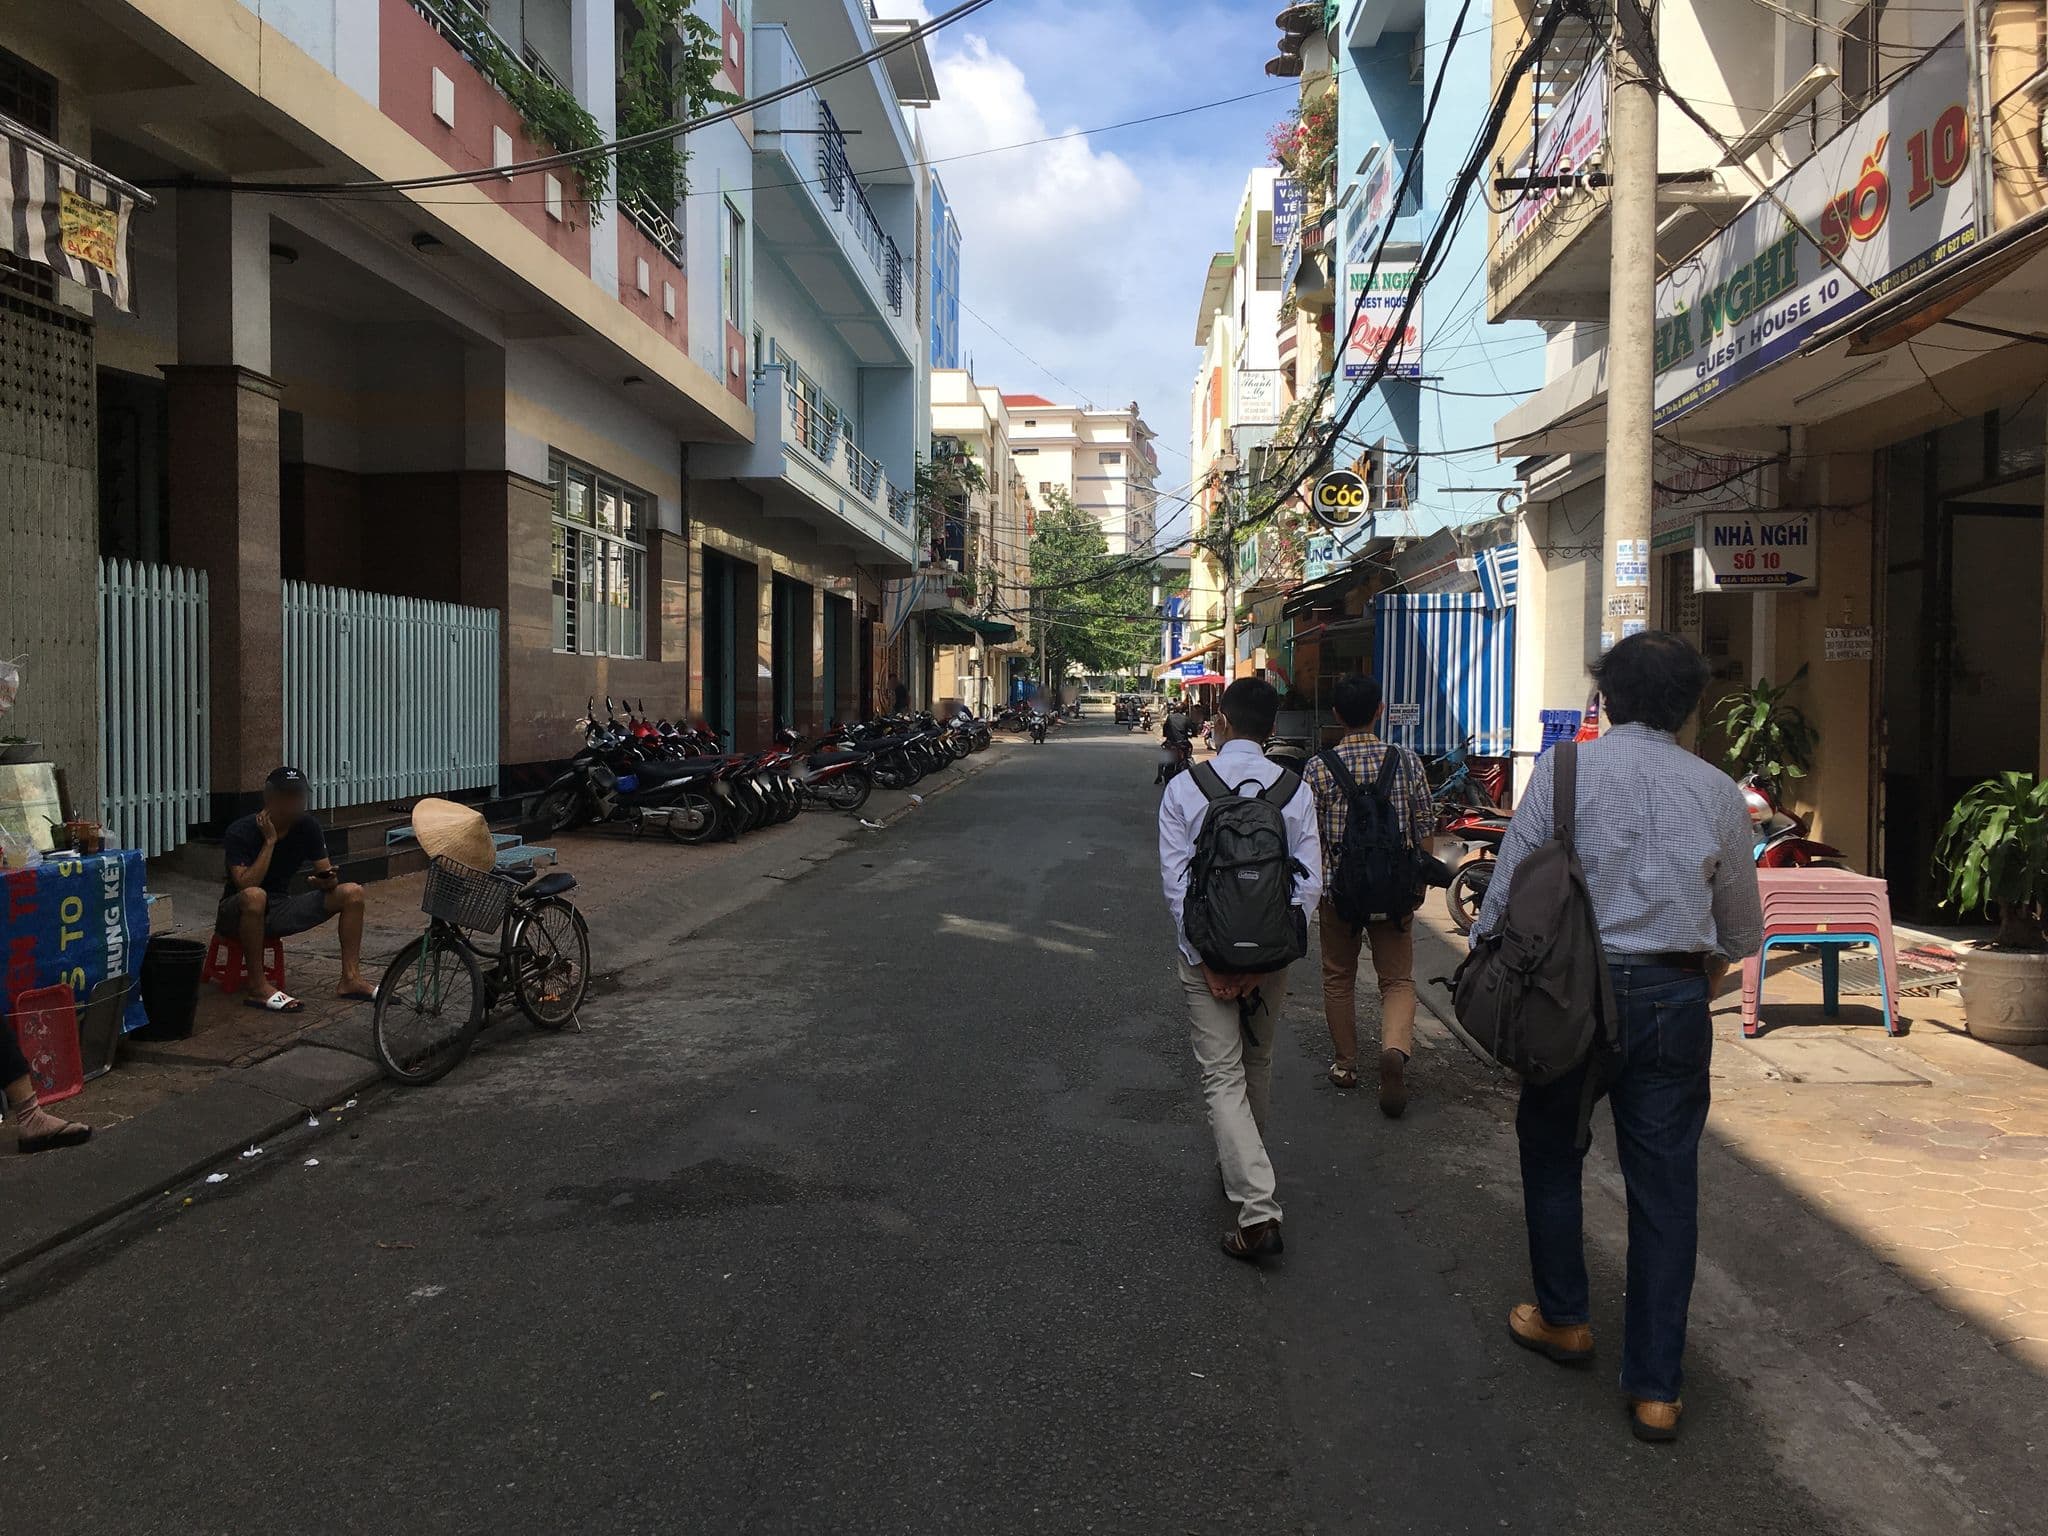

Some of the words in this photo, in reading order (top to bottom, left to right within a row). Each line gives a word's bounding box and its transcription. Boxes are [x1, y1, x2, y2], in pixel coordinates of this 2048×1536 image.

[1654, 298, 1694, 376] HÀ
[1820, 131, 1890, 269] SỐ
[1907, 104, 1969, 210] 10
[1384, 296, 1409, 309] HOUS
[1696, 335, 1745, 378] GUEST
[1751, 295, 1811, 346] HOUSE
[1818, 278, 1840, 304] 10
[1321, 484, 1362, 506] Cóc
[1714, 520, 1754, 546] NHÀ
[1761, 517, 1808, 546] NGHỈ
[1733, 548, 1757, 570] SỐ
[1761, 552, 1781, 569] 10
[61, 896, 84, 951] TO
[104, 906, 124, 979] HUNG
